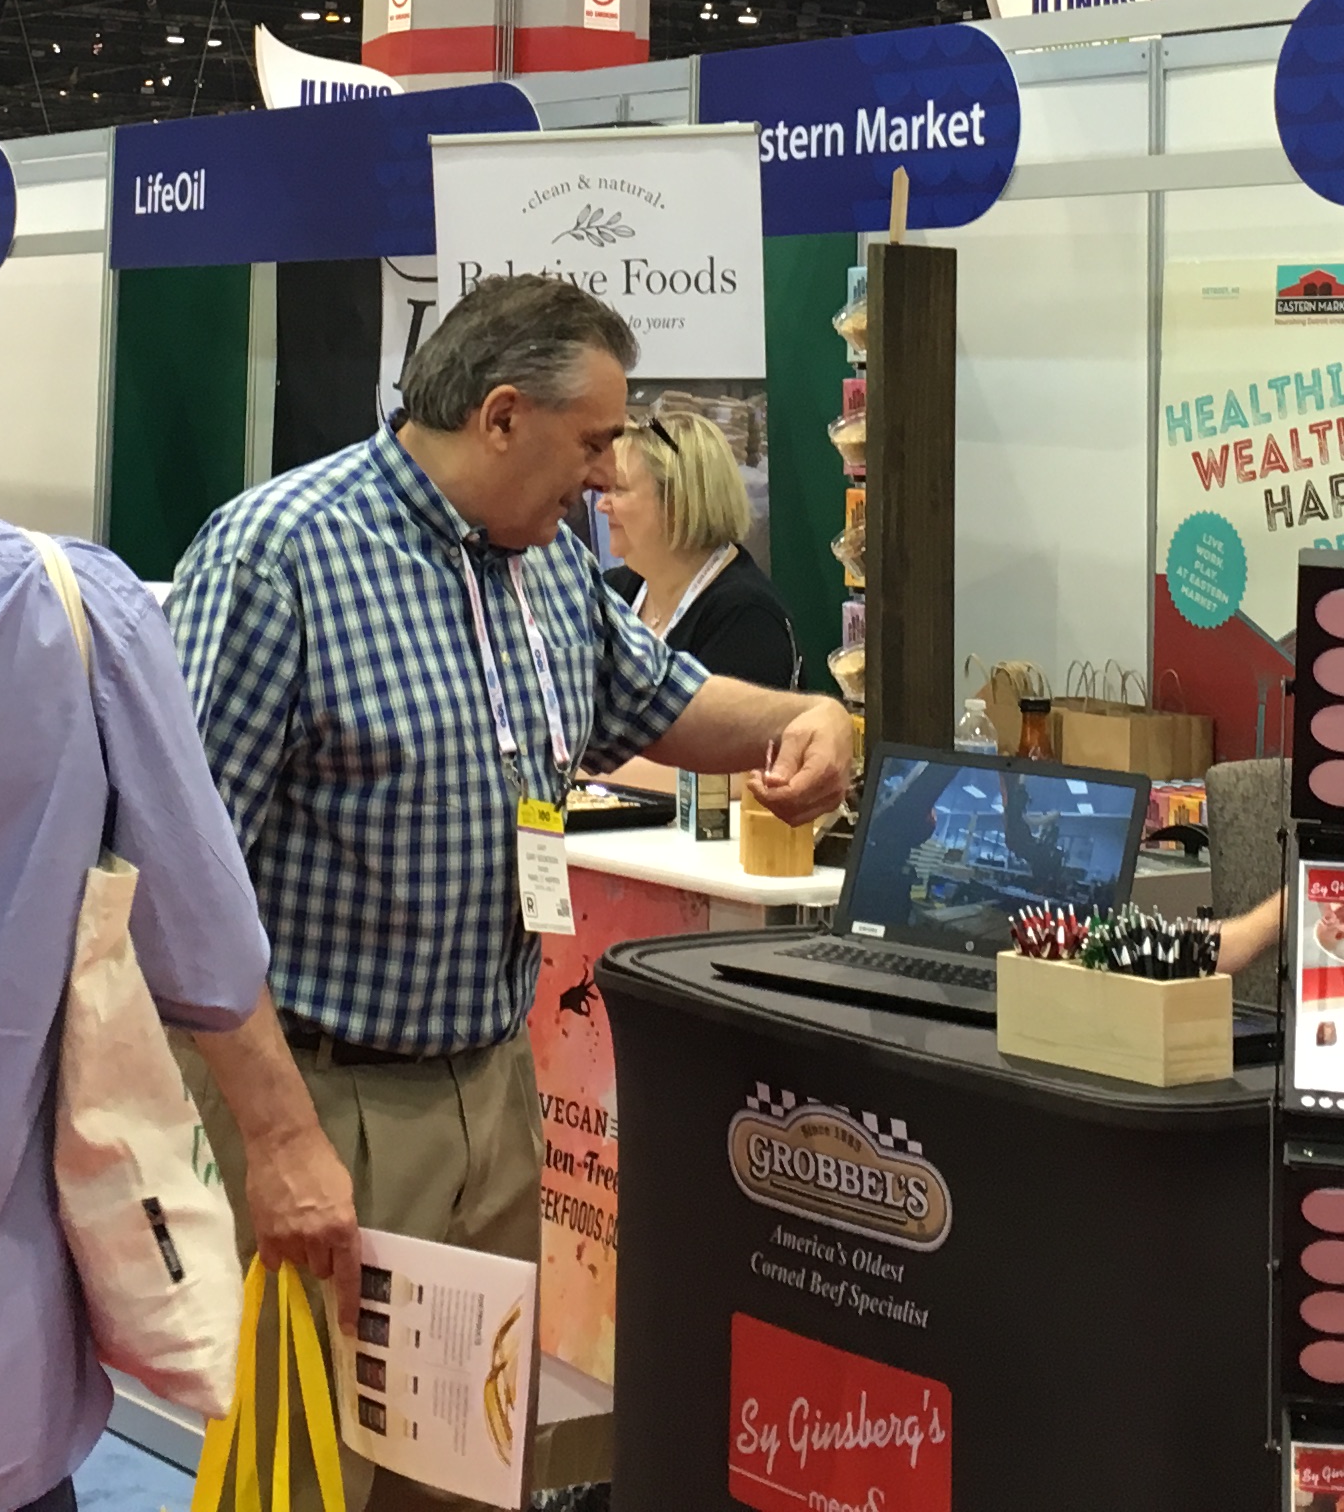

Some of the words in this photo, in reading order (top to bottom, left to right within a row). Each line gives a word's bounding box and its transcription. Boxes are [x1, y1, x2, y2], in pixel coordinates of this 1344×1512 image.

[760, 118, 845, 163] stern
[856, 99, 986, 156] Market
[134, 168, 206, 215] LifeOil
[621, 256, 737, 296] Foods
[642, 316, 685, 336] yours
[1277, 300, 1316, 313] EASTERN
[526, 896, 535, 914] R
[538, 1091, 609, 1139] VEGAN
[748, 1133, 930, 1219] GROBBEL'S
[769, 1224, 849, 1273] America's
[851, 1248, 906, 1284] Oldest
[750, 1251, 807, 1290] Corned
[808, 1271, 848, 1308] Beef
[847, 1284, 930, 1330] Specialist
[736, 1397, 781, 1476] Sy
[787, 1388, 946, 1470] Ginsberg's
